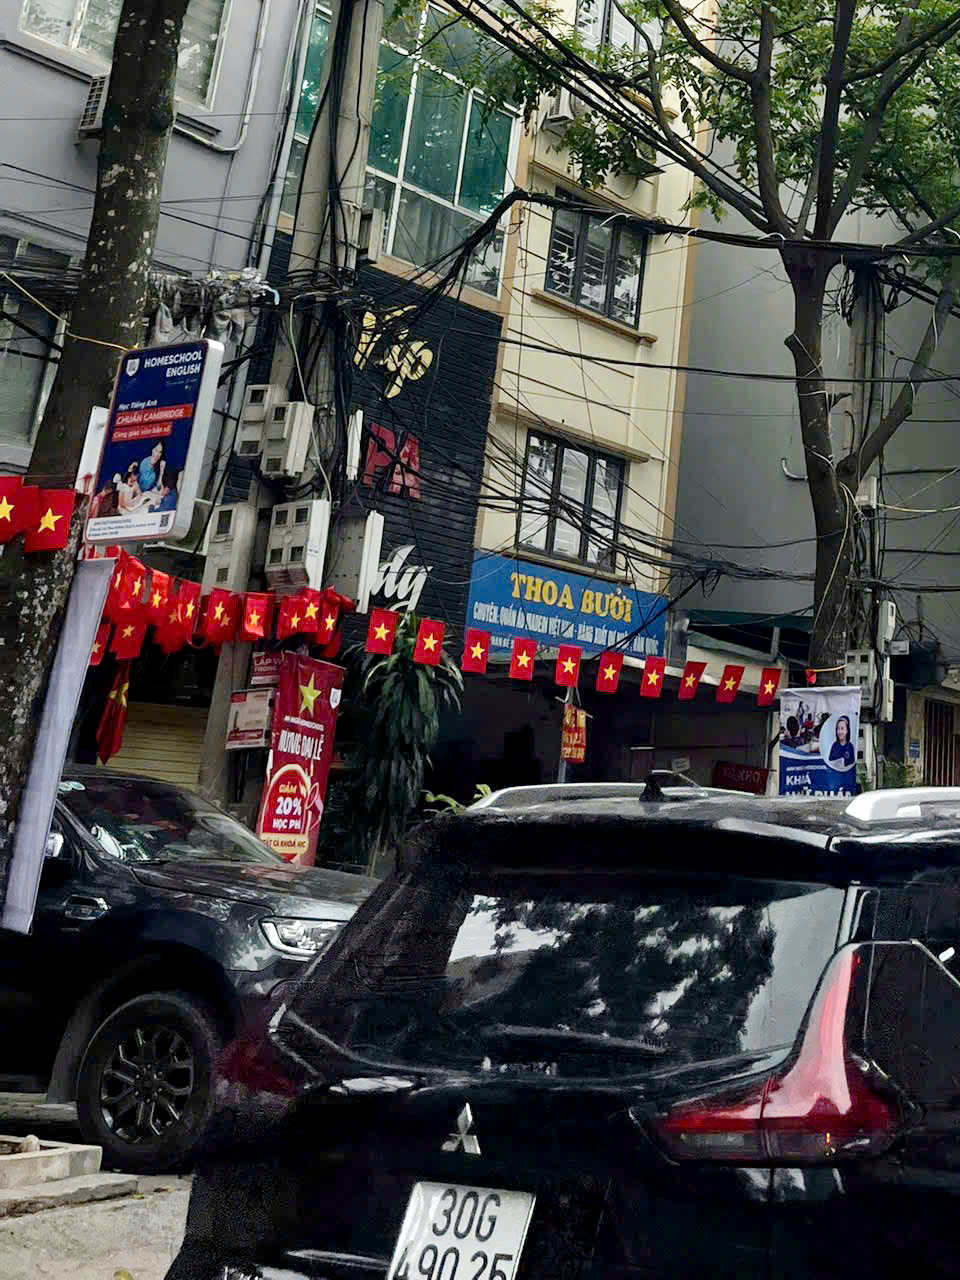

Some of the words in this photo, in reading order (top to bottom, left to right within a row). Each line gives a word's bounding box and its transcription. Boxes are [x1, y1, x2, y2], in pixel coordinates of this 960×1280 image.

[144, 350, 203, 369] HOMESCHOOL
[165, 363, 201, 378] ENGLISH
[143, 408, 184, 421] CAMBRIDGE
[362, 423, 421, 499] PA
[510, 572, 574, 610] THOA
[580, 586, 633, 623] BƯỞI
[786, 771, 811, 786] KHÁ
[275, 796, 302, 816] 20%
[272, 818, 288, 831] HỌC
[432, 1188, 501, 1242] 30G
